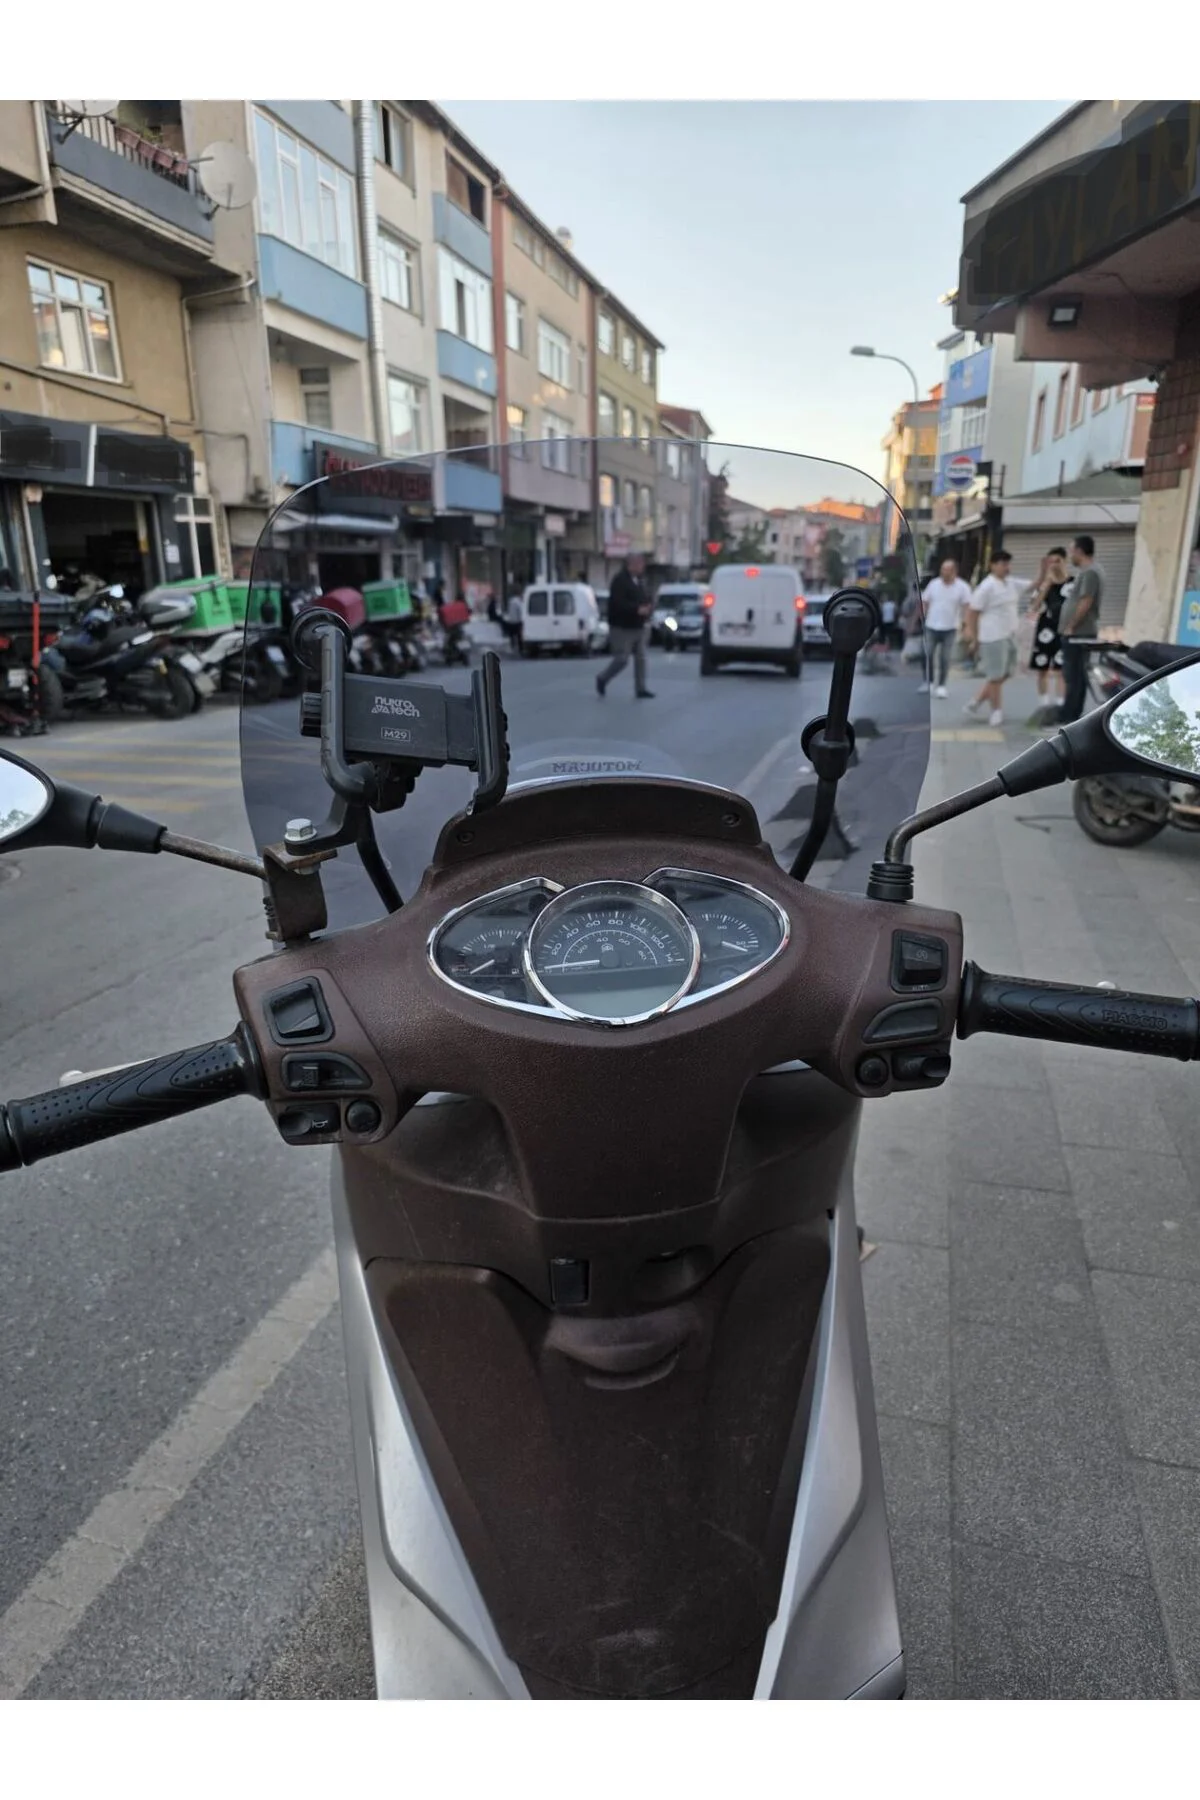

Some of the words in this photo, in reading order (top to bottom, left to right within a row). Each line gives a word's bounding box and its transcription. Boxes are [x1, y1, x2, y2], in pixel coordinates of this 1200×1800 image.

[390, 704, 421, 718] tech
[383, 729, 408, 740] M29
[551, 942, 562, 956] 20
[566, 927, 579, 939] 40
[585, 919, 601, 928] 60
[607, 918, 624, 926] 80
[629, 922, 648, 935] 100
[651, 934, 665, 949] 120
[1102, 1010, 1168, 1031] PIAGGIO
